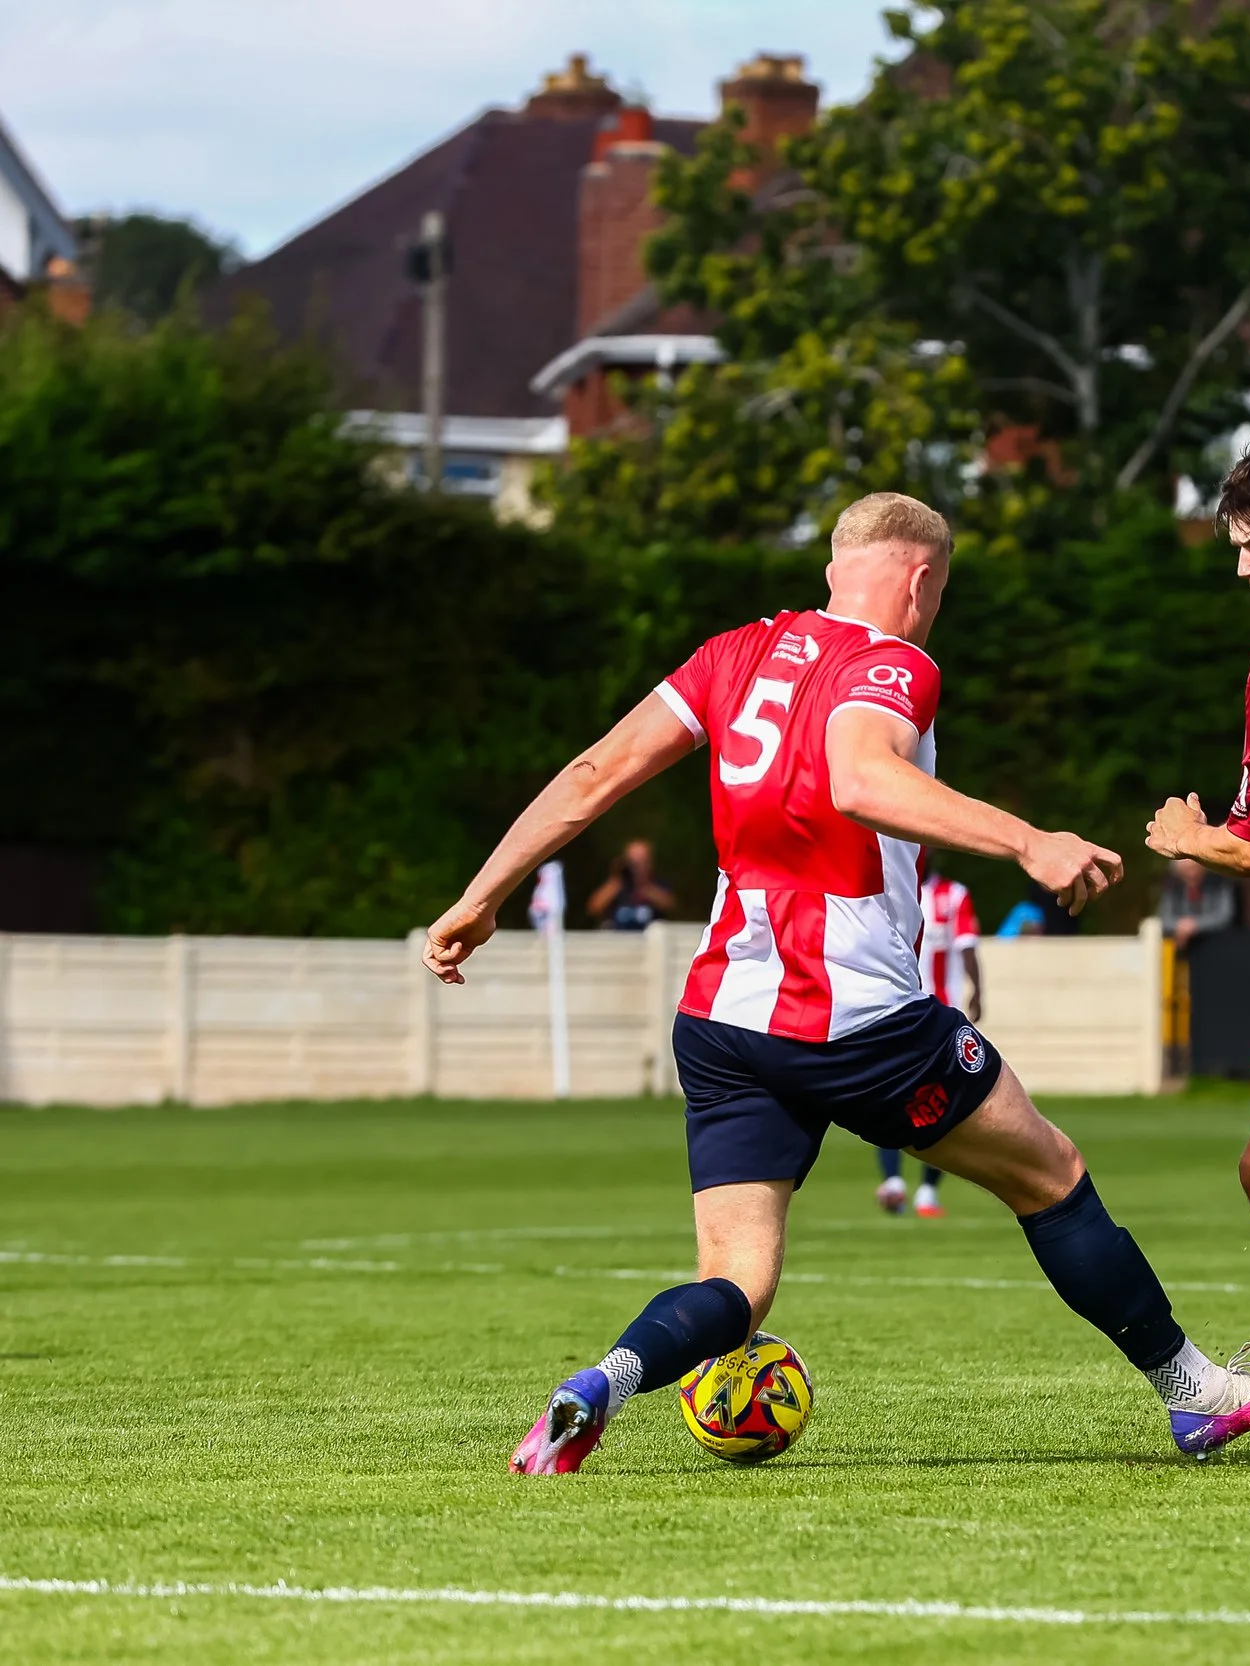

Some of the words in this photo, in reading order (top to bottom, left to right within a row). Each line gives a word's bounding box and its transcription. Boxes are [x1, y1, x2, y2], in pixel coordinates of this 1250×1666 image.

[867, 664, 913, 696] OR
[718, 676, 796, 786] 5
[1184, 1419, 1215, 1442] SKX
